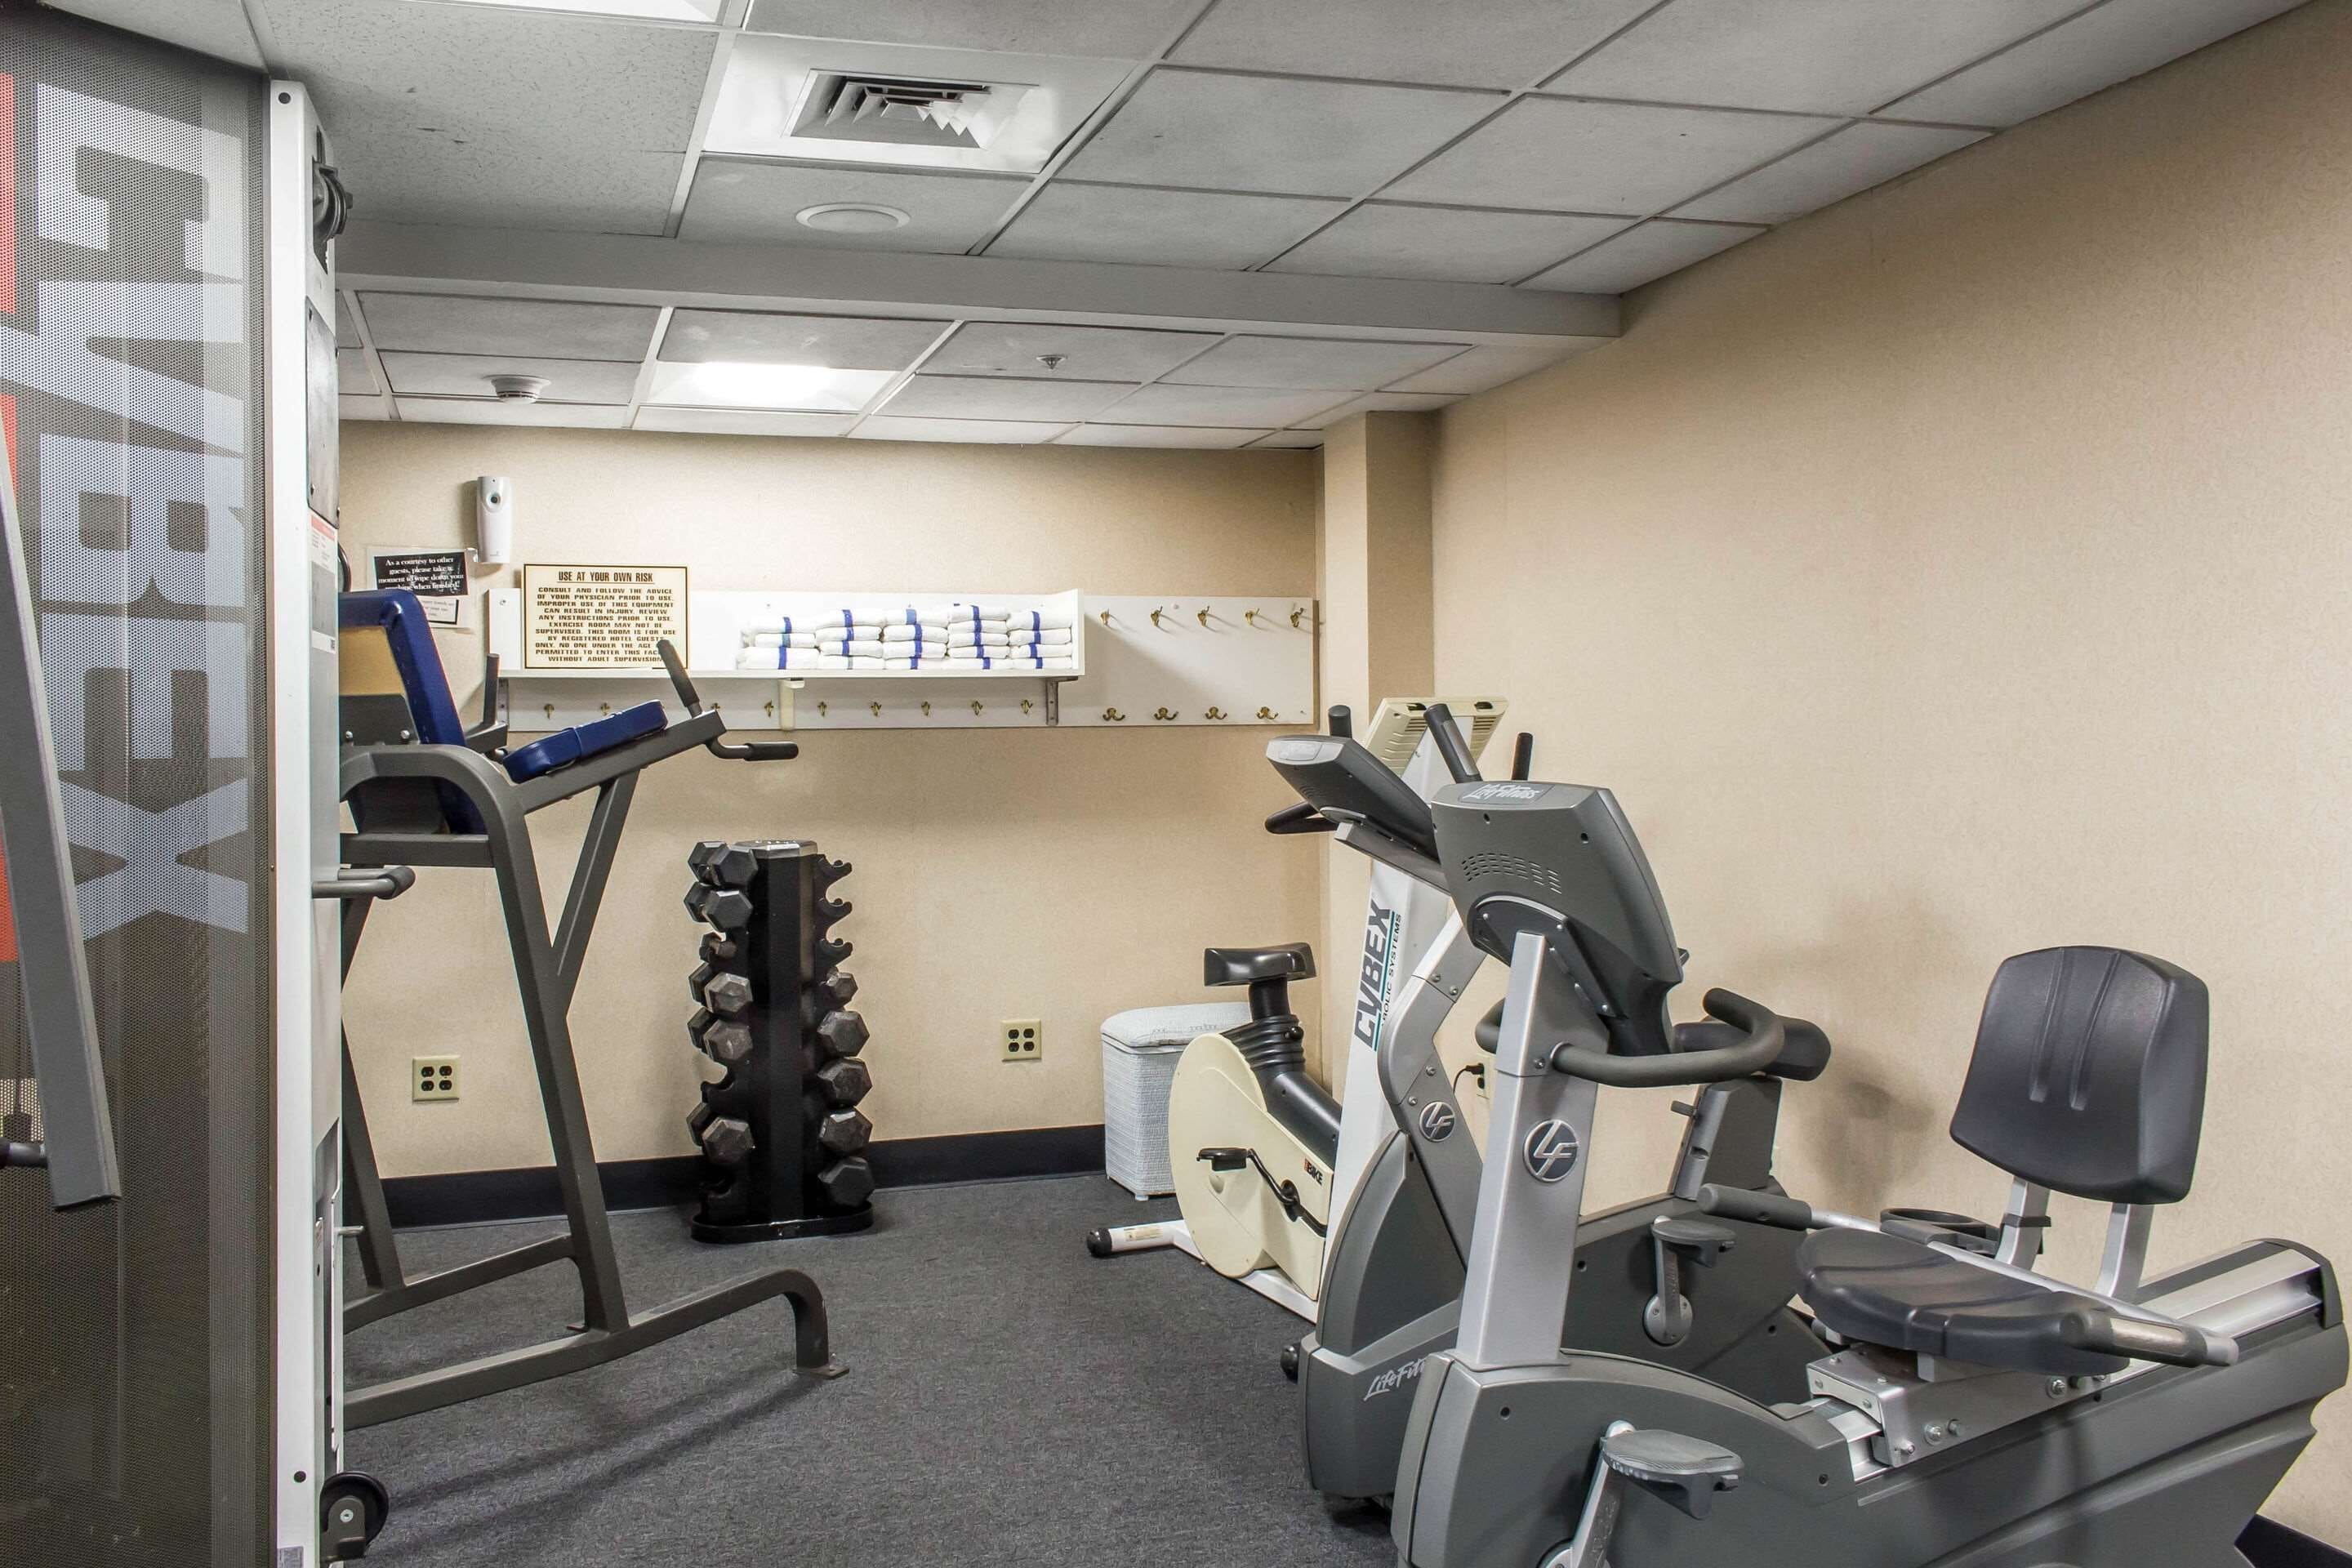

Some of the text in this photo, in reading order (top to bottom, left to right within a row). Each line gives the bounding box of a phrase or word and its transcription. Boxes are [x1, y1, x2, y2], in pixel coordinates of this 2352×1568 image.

[0, 82, 248, 942] CYBEX
[401, 558, 427, 566] courtesy
[412, 566, 431, 574] please
[379, 576, 405, 584] moment
[559, 572, 653, 582] USE AT YOUR OWN RISK
[1389, 913, 1401, 978] SYSTEMS
[1354, 898, 1392, 1048] CYBEX
